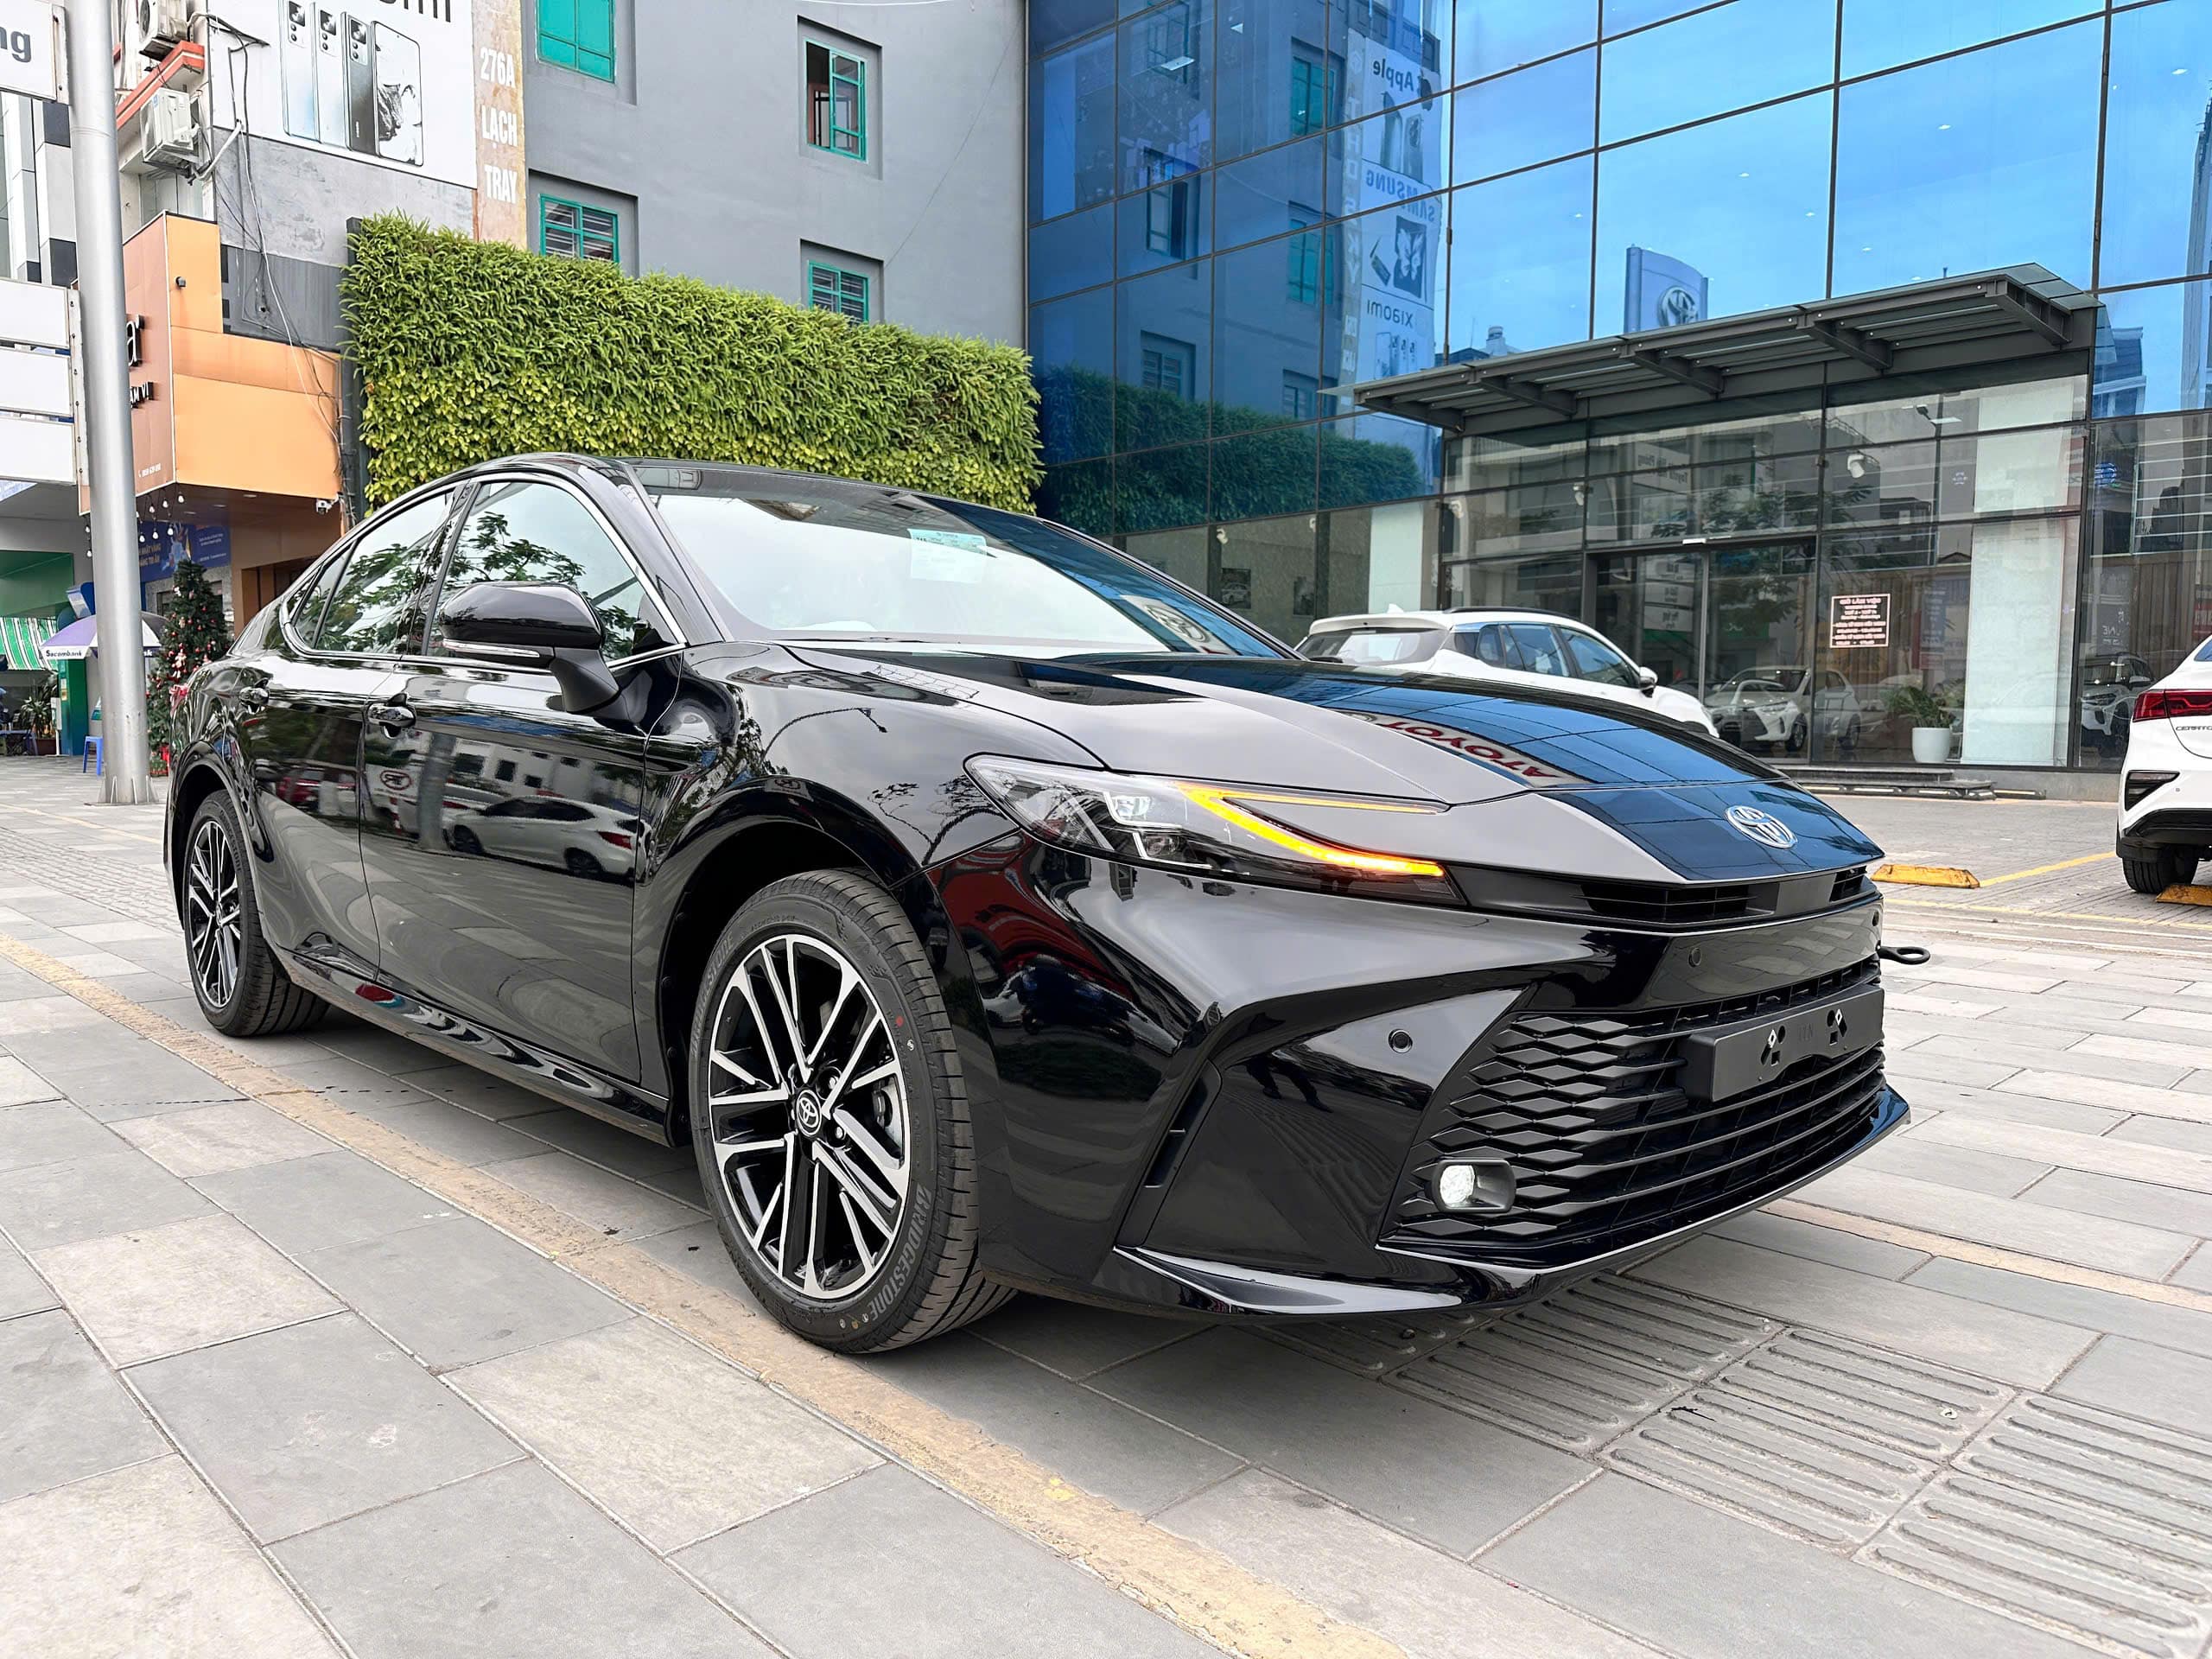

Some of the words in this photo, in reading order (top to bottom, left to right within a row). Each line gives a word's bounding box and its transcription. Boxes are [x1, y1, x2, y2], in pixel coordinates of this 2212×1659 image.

[480, 46, 515, 88] 276A
[481, 105, 518, 149] LẠCH
[484, 163, 518, 205] TRAY
[868, 1183, 932, 1321] BRIDGESTONE
